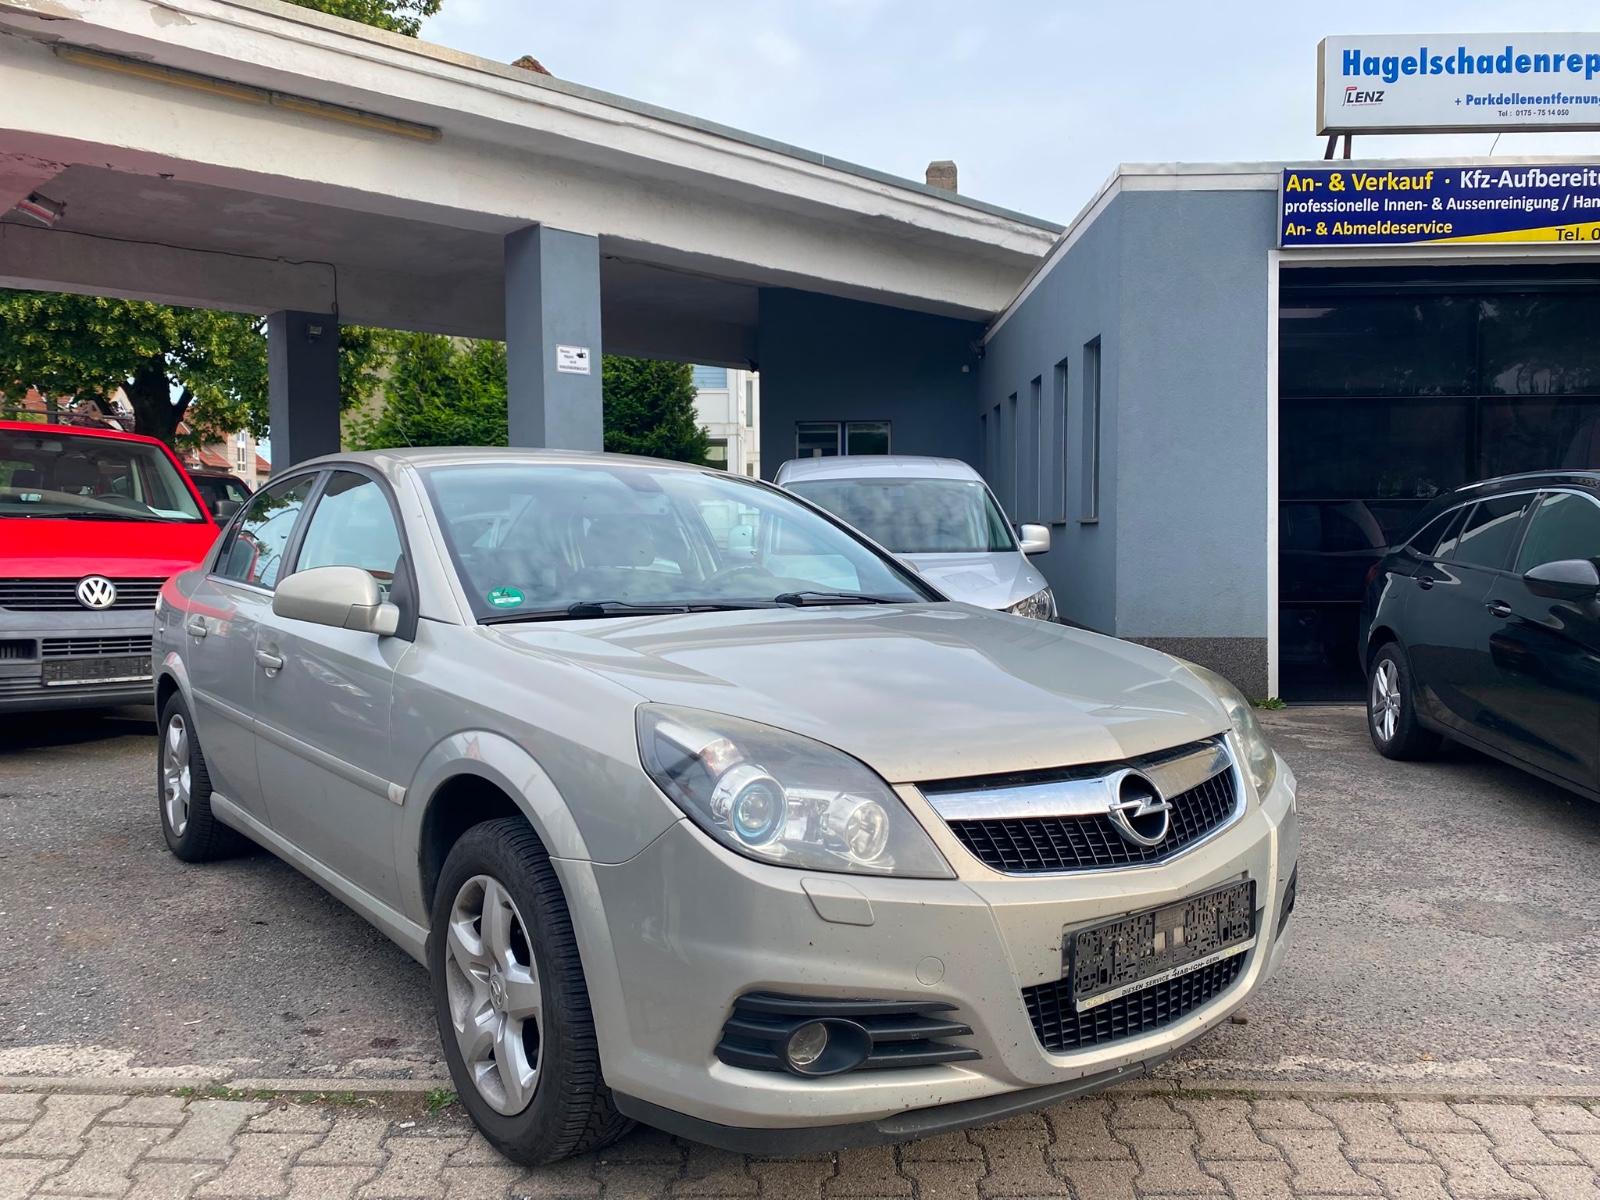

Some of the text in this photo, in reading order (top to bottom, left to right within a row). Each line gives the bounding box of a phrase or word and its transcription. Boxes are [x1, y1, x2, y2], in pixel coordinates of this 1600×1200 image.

[1343, 46, 1600, 84] Hagelschadenrep
[1346, 90, 1385, 104] LENZ
[1466, 92, 1600, 106] Parkdellenentfernun
[1515, 109, 1532, 117] 0175
[1286, 174, 1323, 192] An-
[1328, 173, 1345, 191] &
[1352, 171, 1434, 191] Verkauf
[1460, 168, 1600, 189] Kfz-Aufbereit
[1285, 198, 1379, 216] professionelle
[1384, 198, 1428, 212] Innen-
[1431, 197, 1443, 211] &
[1446, 195, 1559, 212] Aussenreinigung
[1562, 194, 1570, 211] /
[1285, 220, 1453, 236] An- & Abmeldeservice
[1555, 227, 1584, 241] Tel.
[1145, 974, 1170, 987] SERVICE
